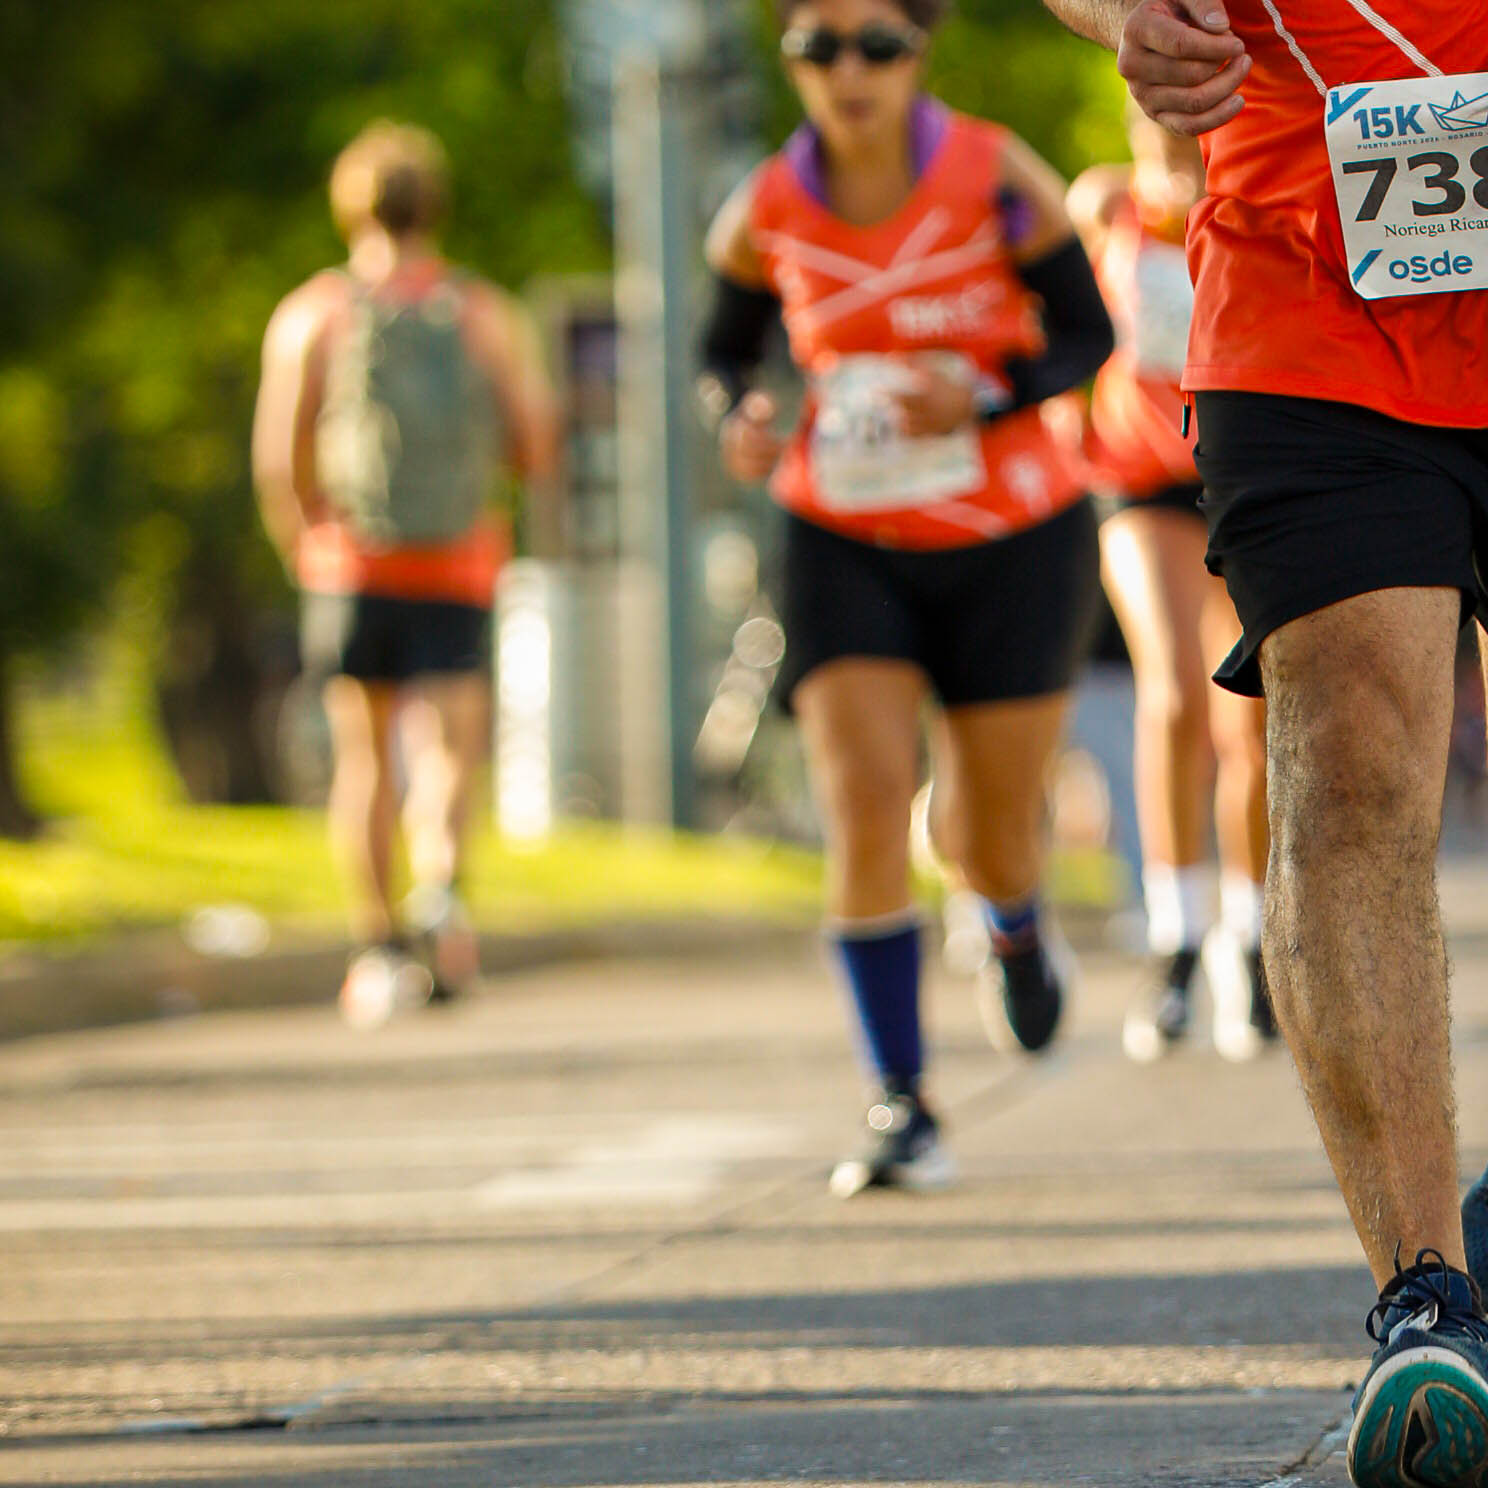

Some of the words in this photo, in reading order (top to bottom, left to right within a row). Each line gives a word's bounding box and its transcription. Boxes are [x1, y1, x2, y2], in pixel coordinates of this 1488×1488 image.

[1353, 103, 1426, 140] 15K
[1357, 142, 1389, 150] PUERTO
[1391, 139, 1417, 147] NORTE
[1448, 131, 1483, 140] ROSARIO
[1383, 221, 1446, 238] Noriega
[1388, 250, 1473, 281] osde
